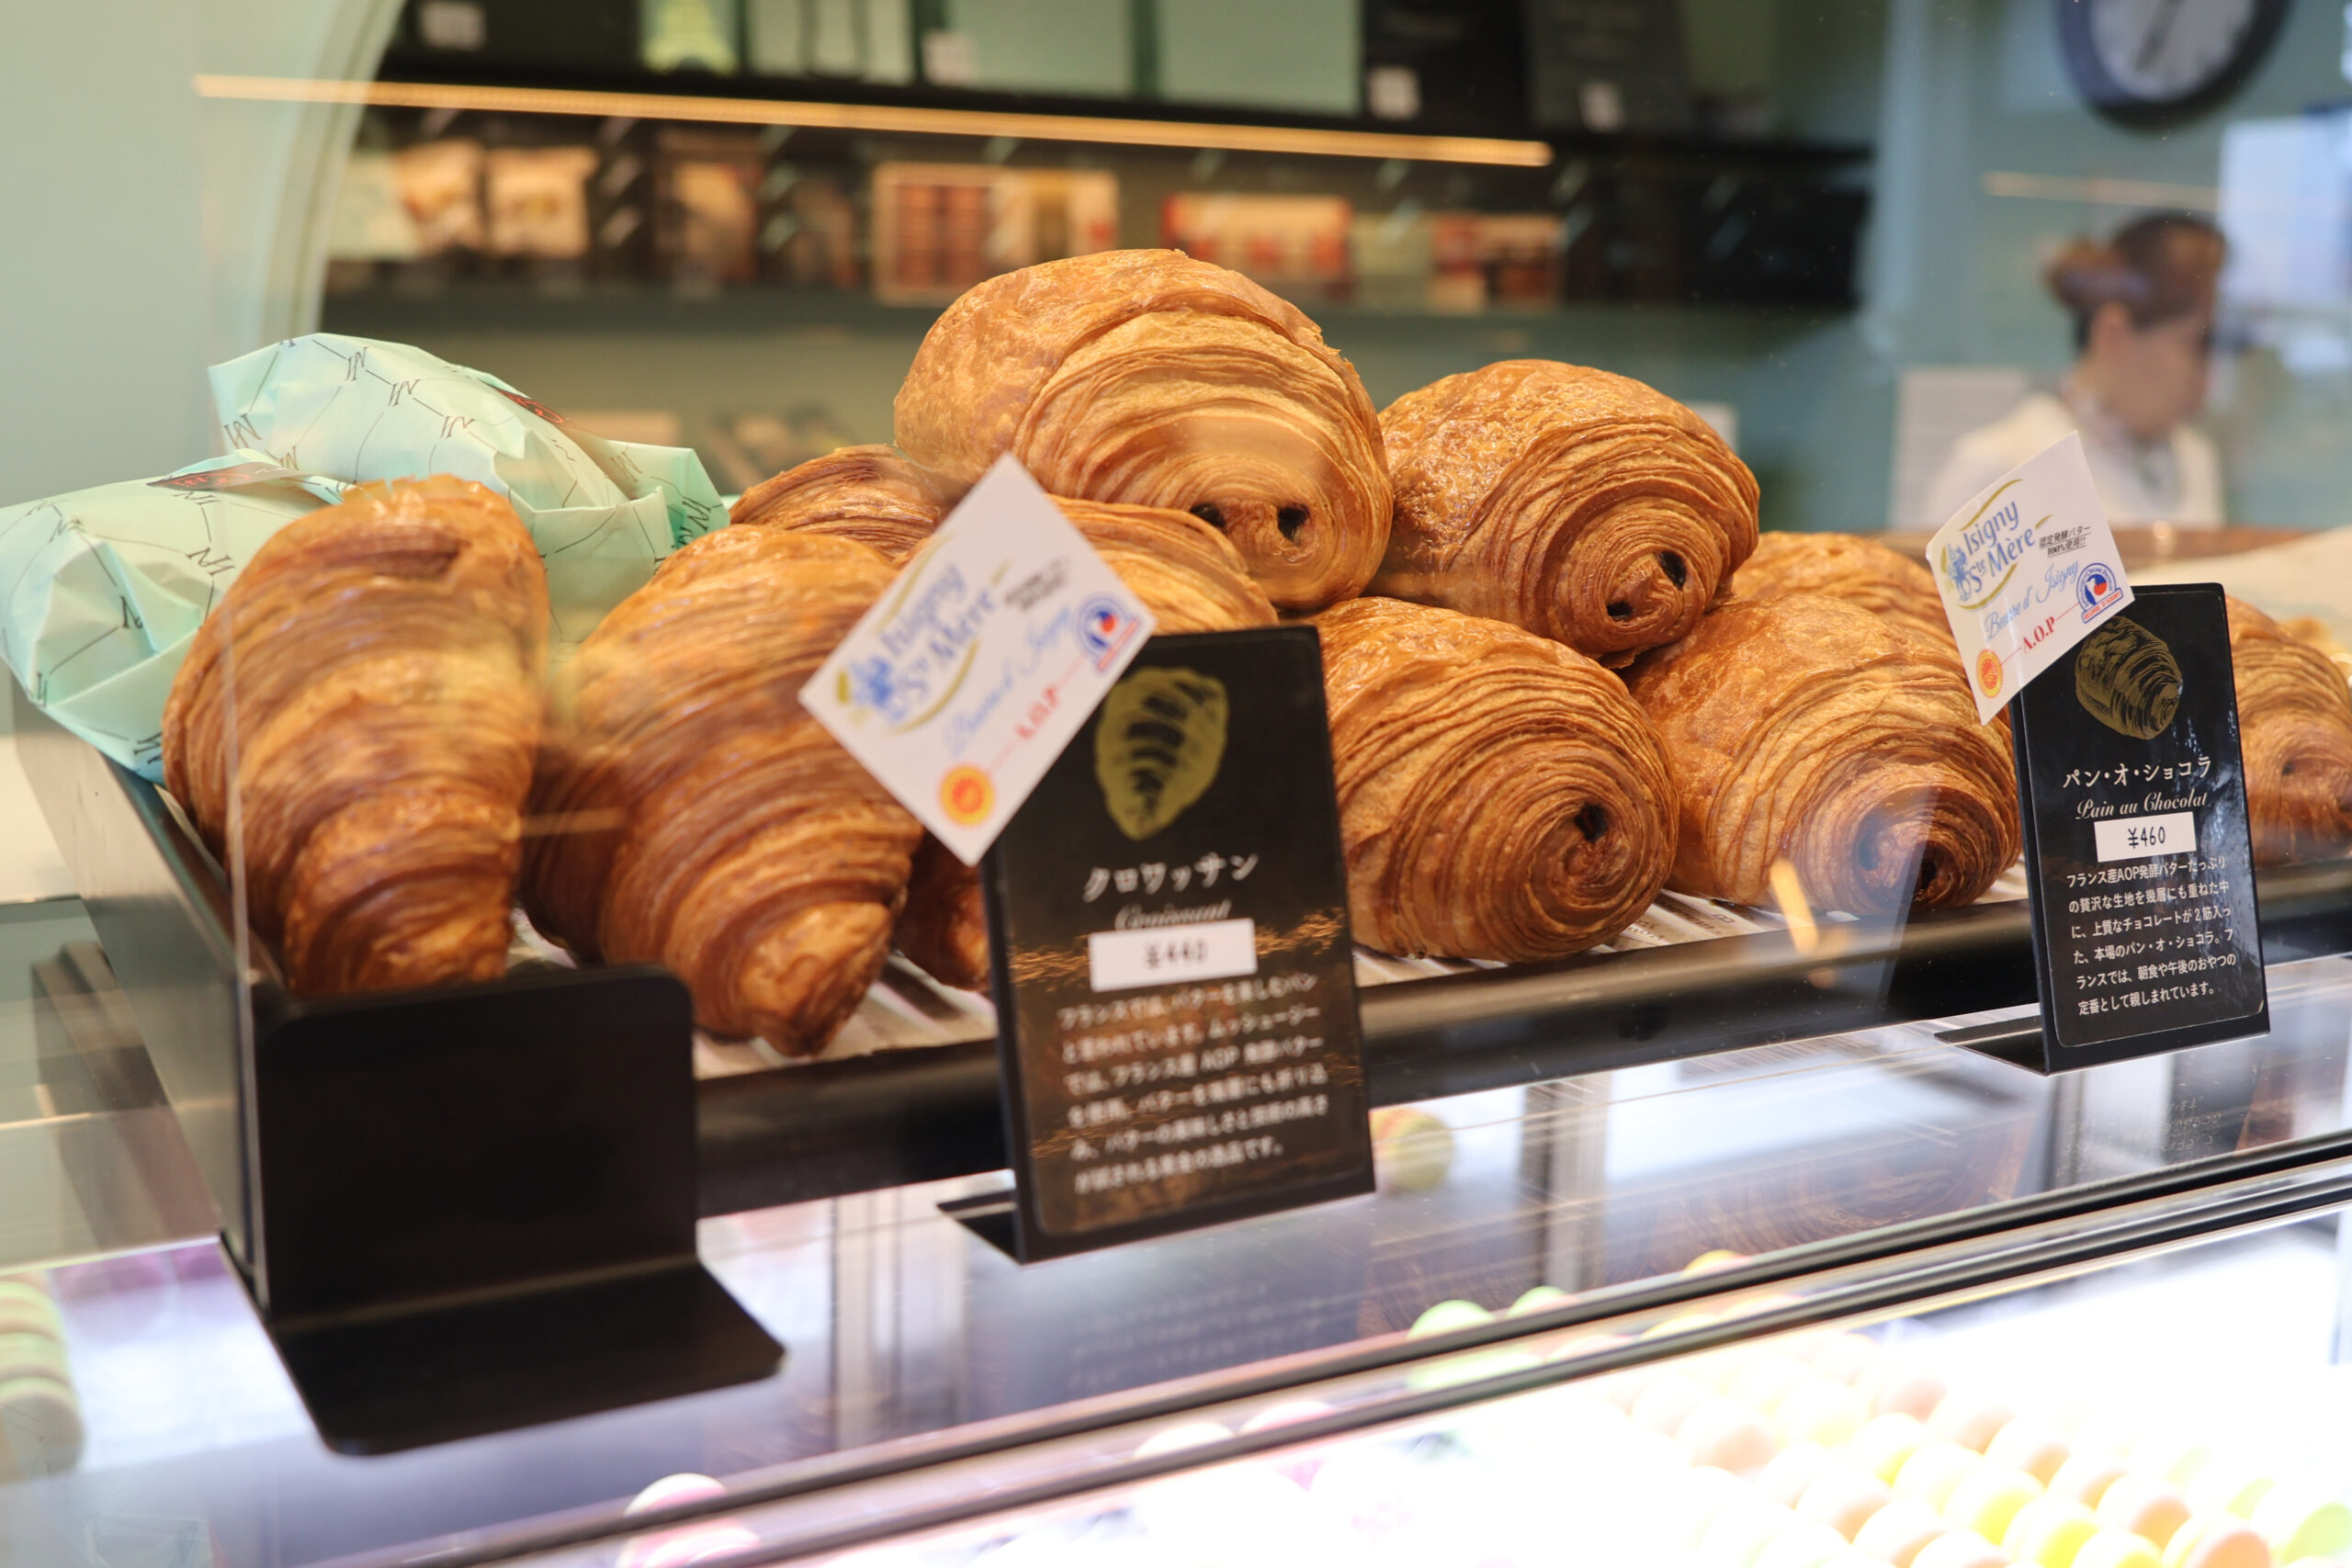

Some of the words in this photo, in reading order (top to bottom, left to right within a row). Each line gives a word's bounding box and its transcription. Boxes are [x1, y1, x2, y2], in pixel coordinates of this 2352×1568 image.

[1962, 501, 2019, 556] Isigny
[1987, 527, 2036, 578] Mère
[2035, 560, 2078, 604] Isigny
[2062, 755, 2211, 789] パン・オ・ショコラ
[2075, 798, 2115, 819] Pain
[2120, 802, 2139, 815] au
[2143, 788, 2209, 812] Chocolat
[2128, 826, 2166, 850] ¥460
[1081, 851, 1260, 904] クロワッサン
[2067, 855, 2226, 888] フランス産AOP発酵バターたっぷり
[2069, 879, 2230, 914] の贅沢な生地を幾層にも重ねた中
[2074, 929, 2234, 965] た、本場のパン・オ・ショコラ。フ
[2075, 953, 2237, 990] ランスでは、朝食や午後のおやつの
[2078, 980, 2215, 1017] 定番として親しまれています。
